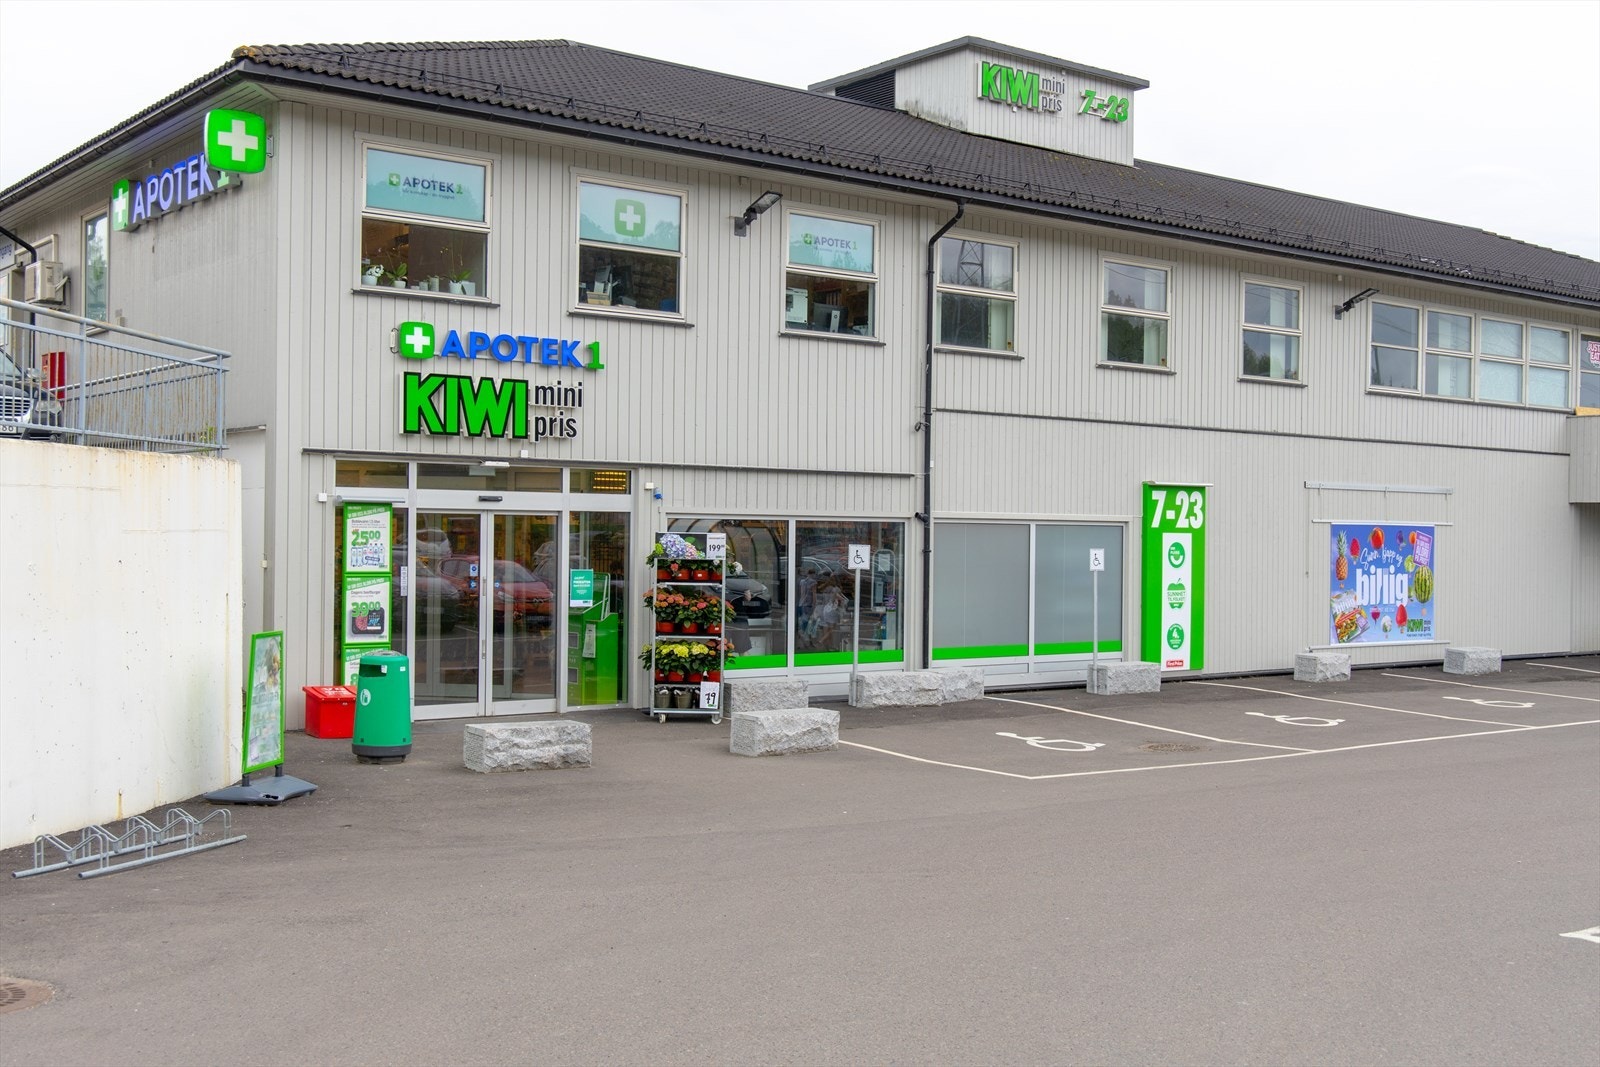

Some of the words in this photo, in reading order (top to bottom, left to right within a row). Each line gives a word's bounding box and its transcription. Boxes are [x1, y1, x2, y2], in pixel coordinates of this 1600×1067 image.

[981, 60, 1040, 108] KIWI
[1041, 76, 1065, 94] mini
[1041, 94, 1063, 112] pris
[1081, 89, 1130, 122] 7-23
[132, 151, 214, 224] APOTEK
[402, 176, 455, 194] APOTEK
[456, 183, 464, 195] 1
[813, 235, 852, 249] APOTEK
[852, 241, 858, 250] 1
[440, 329, 584, 368] APOTEK
[585, 341, 605, 370] 1
[403, 371, 529, 439] KIWI
[534, 380, 583, 408] mini
[534, 411, 578, 442] pris
[1151, 490, 1204, 529] 7-23
[1356, 564, 1409, 607] billig
[1407, 618, 1424, 632] KIWI
